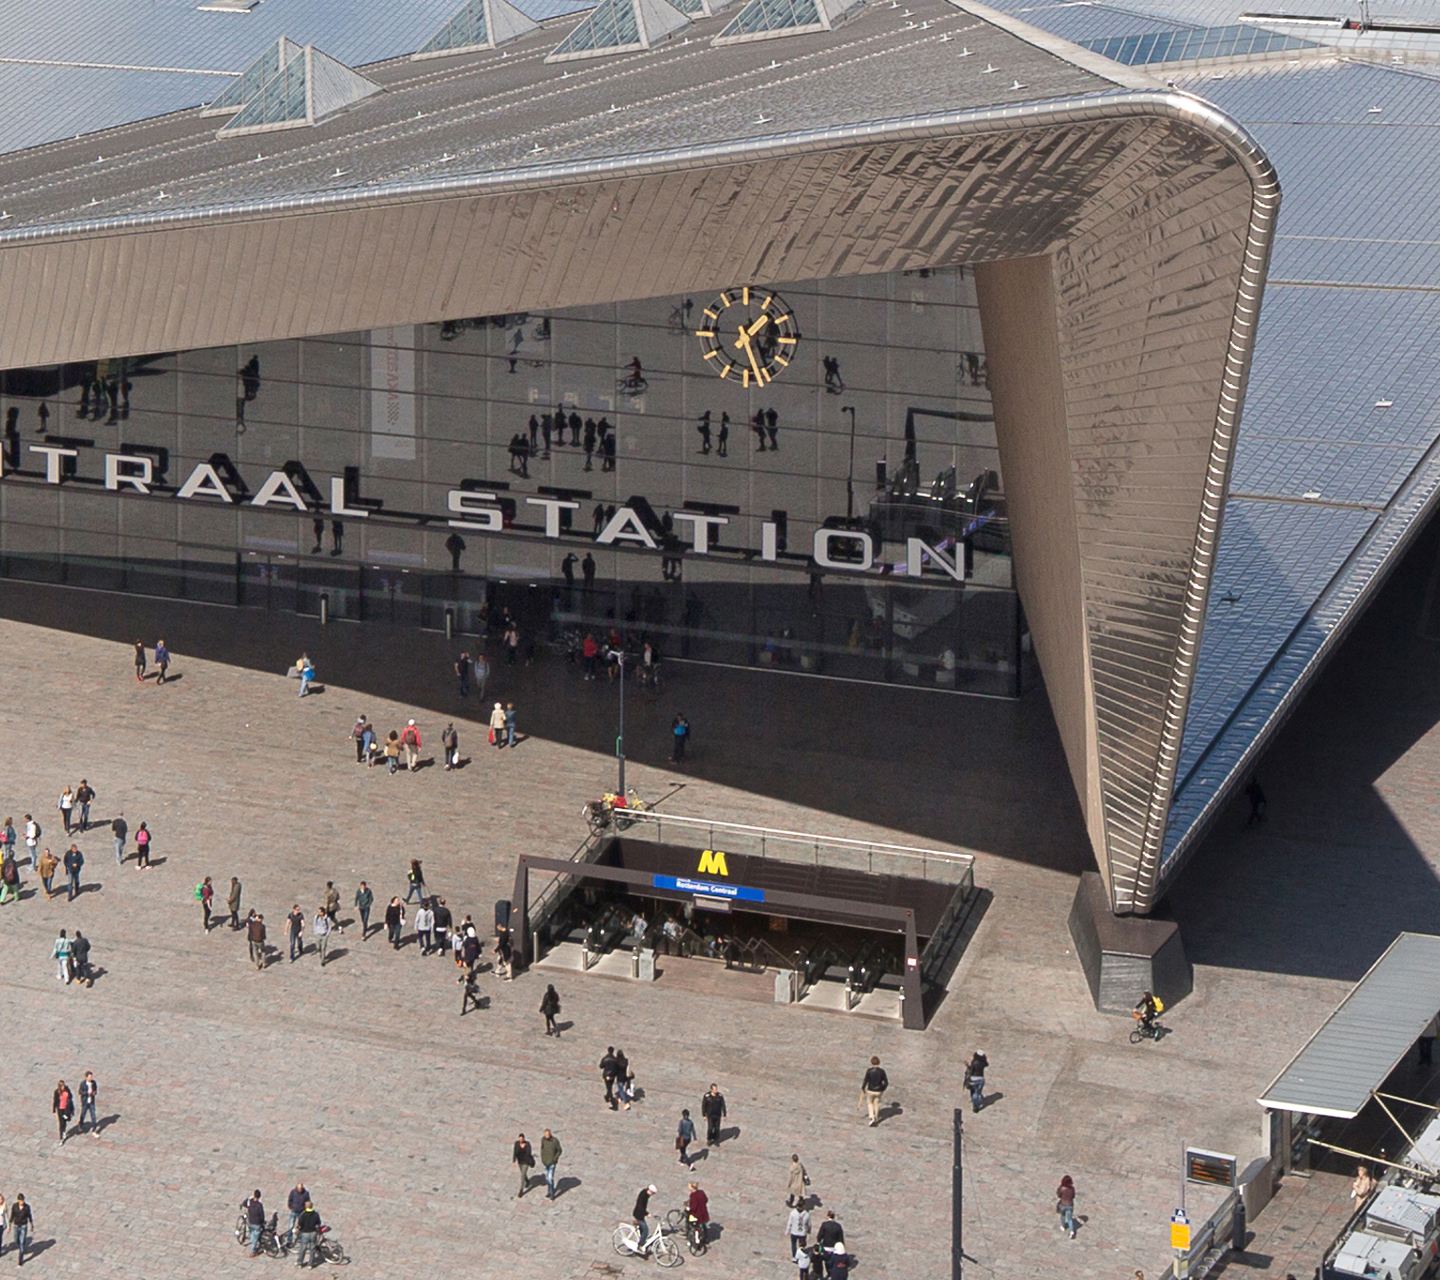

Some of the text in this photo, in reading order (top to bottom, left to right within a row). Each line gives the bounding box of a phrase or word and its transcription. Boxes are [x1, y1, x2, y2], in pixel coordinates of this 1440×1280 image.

[446, 487, 966, 581] STATION
[676, 880, 738, 896] Rotterdam Centraal
